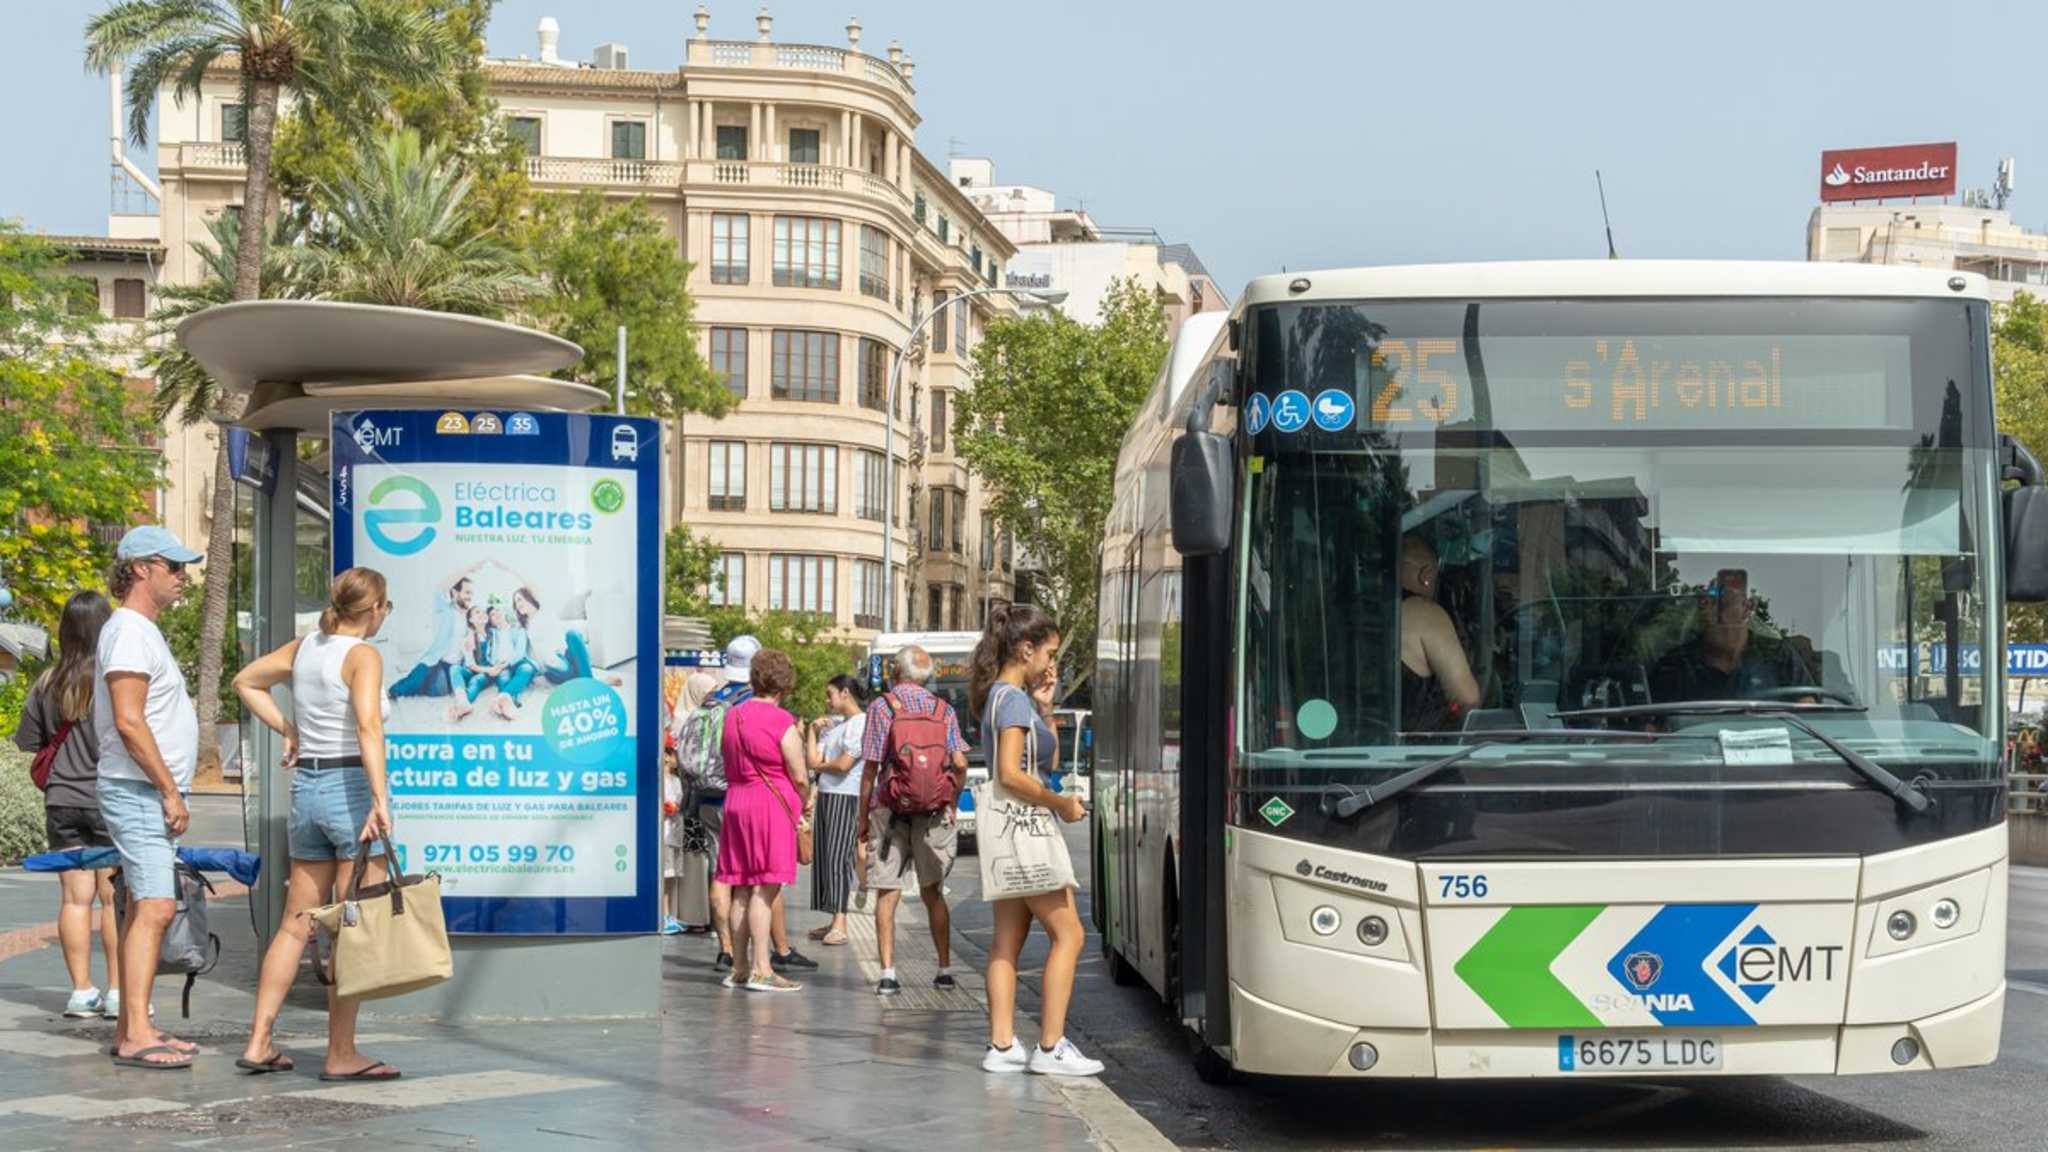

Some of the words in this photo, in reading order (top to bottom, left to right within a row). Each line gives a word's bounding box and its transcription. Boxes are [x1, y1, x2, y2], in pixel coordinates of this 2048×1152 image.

[1853, 160, 1949, 184] Santander
[1370, 340, 1458, 422] 25
[1564, 338, 1783, 421] s'Arenal
[444, 416, 462, 429] 23
[478, 418, 496, 432] 25
[512, 418, 532, 432] 35
[455, 481, 556, 501] Eléctrica
[455, 505, 593, 530] Baleares
[455, 534, 505, 544] NUESTRA
[531, 534, 545, 544] TU
[550, 699, 592, 717] HASTA
[592, 693, 611, 706] UN
[557, 705, 617, 736] 40%
[385, 739, 455, 760] horra
[462, 743, 496, 760] en
[504, 740, 533, 760] tu
[388, 766, 458, 788] ctura
[466, 766, 500, 788] de
[508, 766, 549, 788] luz
[557, 771, 574, 792] y
[581, 771, 627, 792] gas
[392, 801, 430, 812] EJORES
[477, 801, 490, 812] DE
[492, 801, 512, 812] LUZ
[515, 801, 522, 812] Y
[524, 801, 545, 812] GAS
[547, 801, 575, 812] PARA
[577, 801, 628, 812] BALEARES
[1266, 807, 1287, 817] GNC
[424, 844, 461, 862] 971
[469, 844, 500, 862] 05
[507, 844, 538, 862] 99
[545, 844, 575, 862] 70
[1314, 864, 1388, 893] Castrosua
[1438, 875, 1489, 898] 756
[1591, 993, 1695, 1012] SCANIA
[1578, 1040, 1653, 1066] 6675
[1662, 1039, 1716, 1065] LDC
